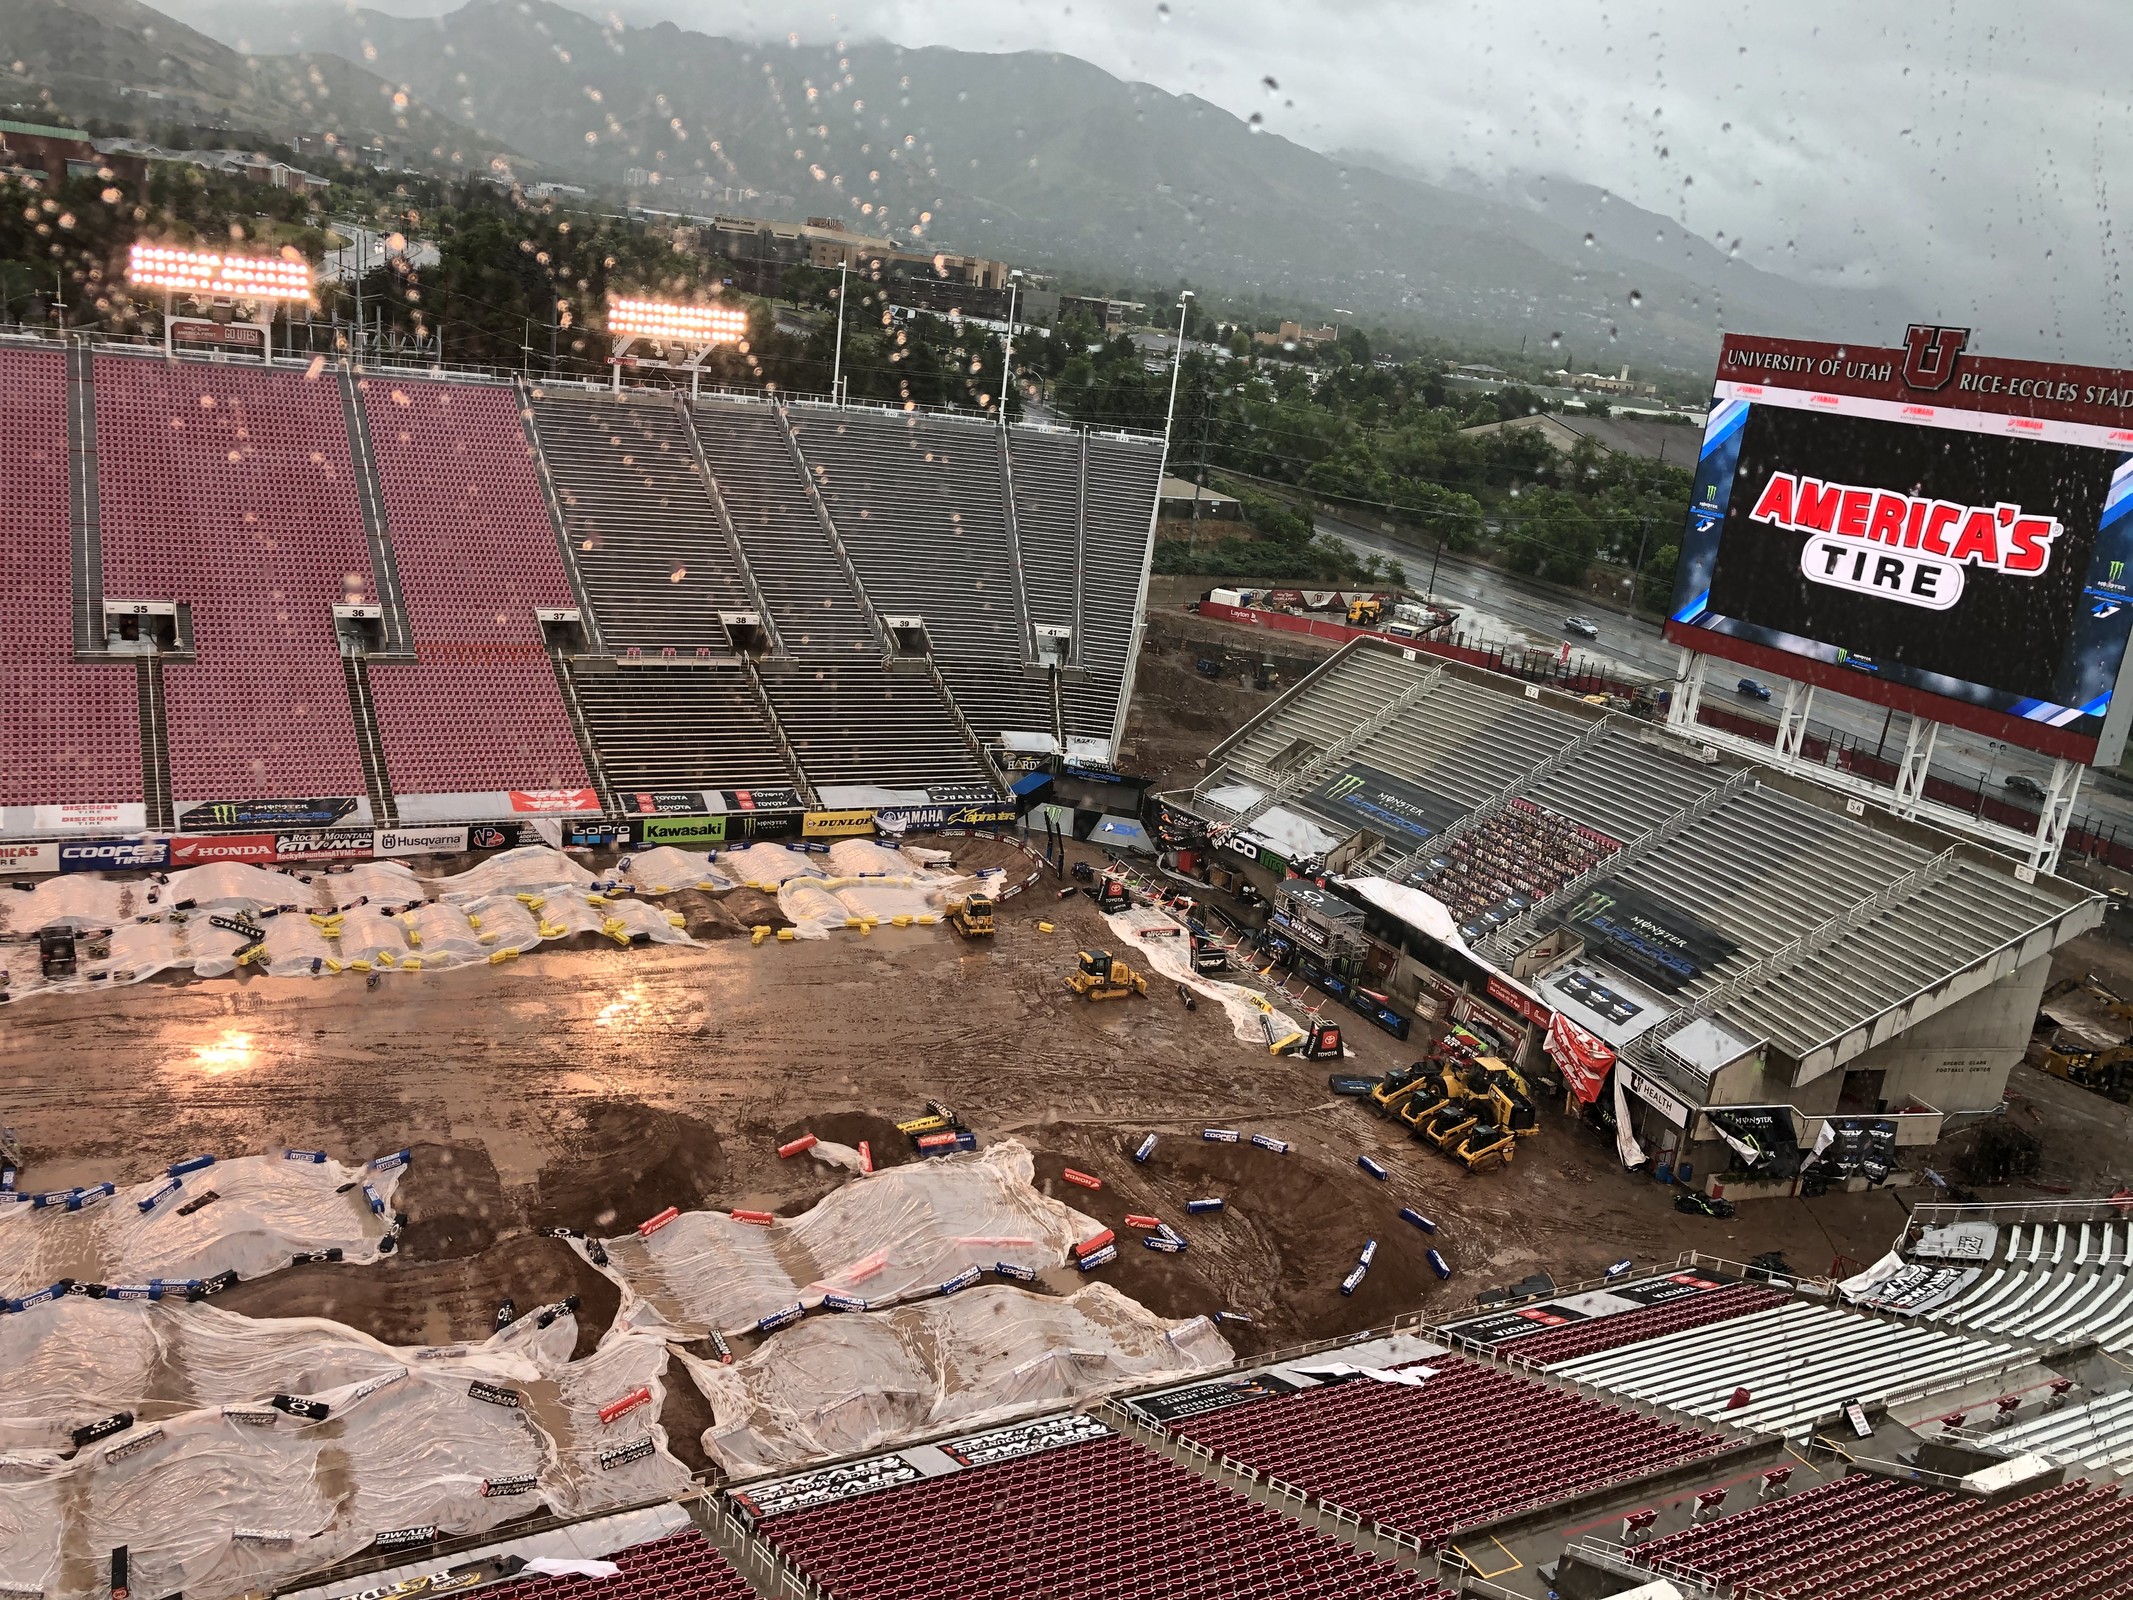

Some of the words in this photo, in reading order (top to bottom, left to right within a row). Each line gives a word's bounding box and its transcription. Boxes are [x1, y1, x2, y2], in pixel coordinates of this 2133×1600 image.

[225, 328, 235, 339] GO
[237, 329, 258, 341] UTES!
[1728, 349, 1816, 375] UNIVERSITY
[1819, 359, 1842, 375] OF
[1846, 361, 1892, 382] UTAH
[1960, 373, 2078, 402] RICE-ECCLES
[1755, 475, 2051, 573] AMERICA'S
[1821, 544, 1943, 598] TIRE
[133, 605, 148, 613] 35
[352, 609, 364, 617] 36
[1377, 792, 1425, 816] MONSTER
[818, 816, 872, 827] DUNLOP
[896, 809, 944, 824] YAMAHA
[1345, 795, 1432, 836] SUPERCROSS
[647, 822, 722, 838] Kawasaki
[757, 819, 788, 827] MONSTER
[291, 834, 322, 842] ROCKY
[324, 831, 371, 841] MOUNTAIN
[572, 825, 631, 836] GoPro
[398, 834, 461, 847] Husqvarna
[62, 844, 168, 859] COOPER
[198, 846, 272, 857] HONDA
[276, 849, 373, 861] RockyMountainATVMC.com
[113, 855, 164, 865] TIRES
[224, 921, 262, 938] OAKLEY
[1630, 915, 1688, 948] MONSTER
[1632, 926, 1671, 948] ENERGY
[1643, 1082, 1673, 1112] HEALTH
[1735, 1115, 1773, 1125] MONSTER
[1204, 1132, 1237, 1140] COOPER
[1253, 1136, 1284, 1150] COOPER
[291, 1153, 316, 1162] WPS
[1064, 1172, 1092, 1185] HONDA
[46, 1192, 75, 1204] WPS
[153, 1187, 175, 1205] WPS
[651, 1211, 678, 1230] HONDA
[741, 1217, 770, 1225] HONDA
[1150, 1240, 1178, 1249] COOPER
[1001, 1267, 1035, 1279] COOPER
[162, 1285, 188, 1294] WPS
[1630, 1281, 1675, 1293] TOYOTA
[1652, 1287, 1697, 1299] TOYOTA
[23, 1292, 52, 1309] WPS
[119, 1290, 149, 1300] WPS
[760, 1302, 801, 1323] COOPER
[828, 1301, 865, 1312] COOPER
[763, 1310, 804, 1331] COOPER
[1473, 1316, 1523, 1329] TOYOTA
[1493, 1322, 1543, 1337] TOYOTA
[614, 1397, 650, 1419] HONDA
[90, 1420, 121, 1435] OAKLEY
[1032, 1424, 1074, 1438] ROCKY
[958, 1434, 1029, 1454] MOUNTAIN
[1049, 1433, 1090, 1447] ROCKY
[972, 1443, 1045, 1464] MOUNTAIN
[836, 1467, 880, 1482] ROCKY
[753, 1479, 831, 1503] MOUNTAIN
[850, 1479, 896, 1494] ROCKY
[765, 1491, 845, 1515] MOUNTAIN
